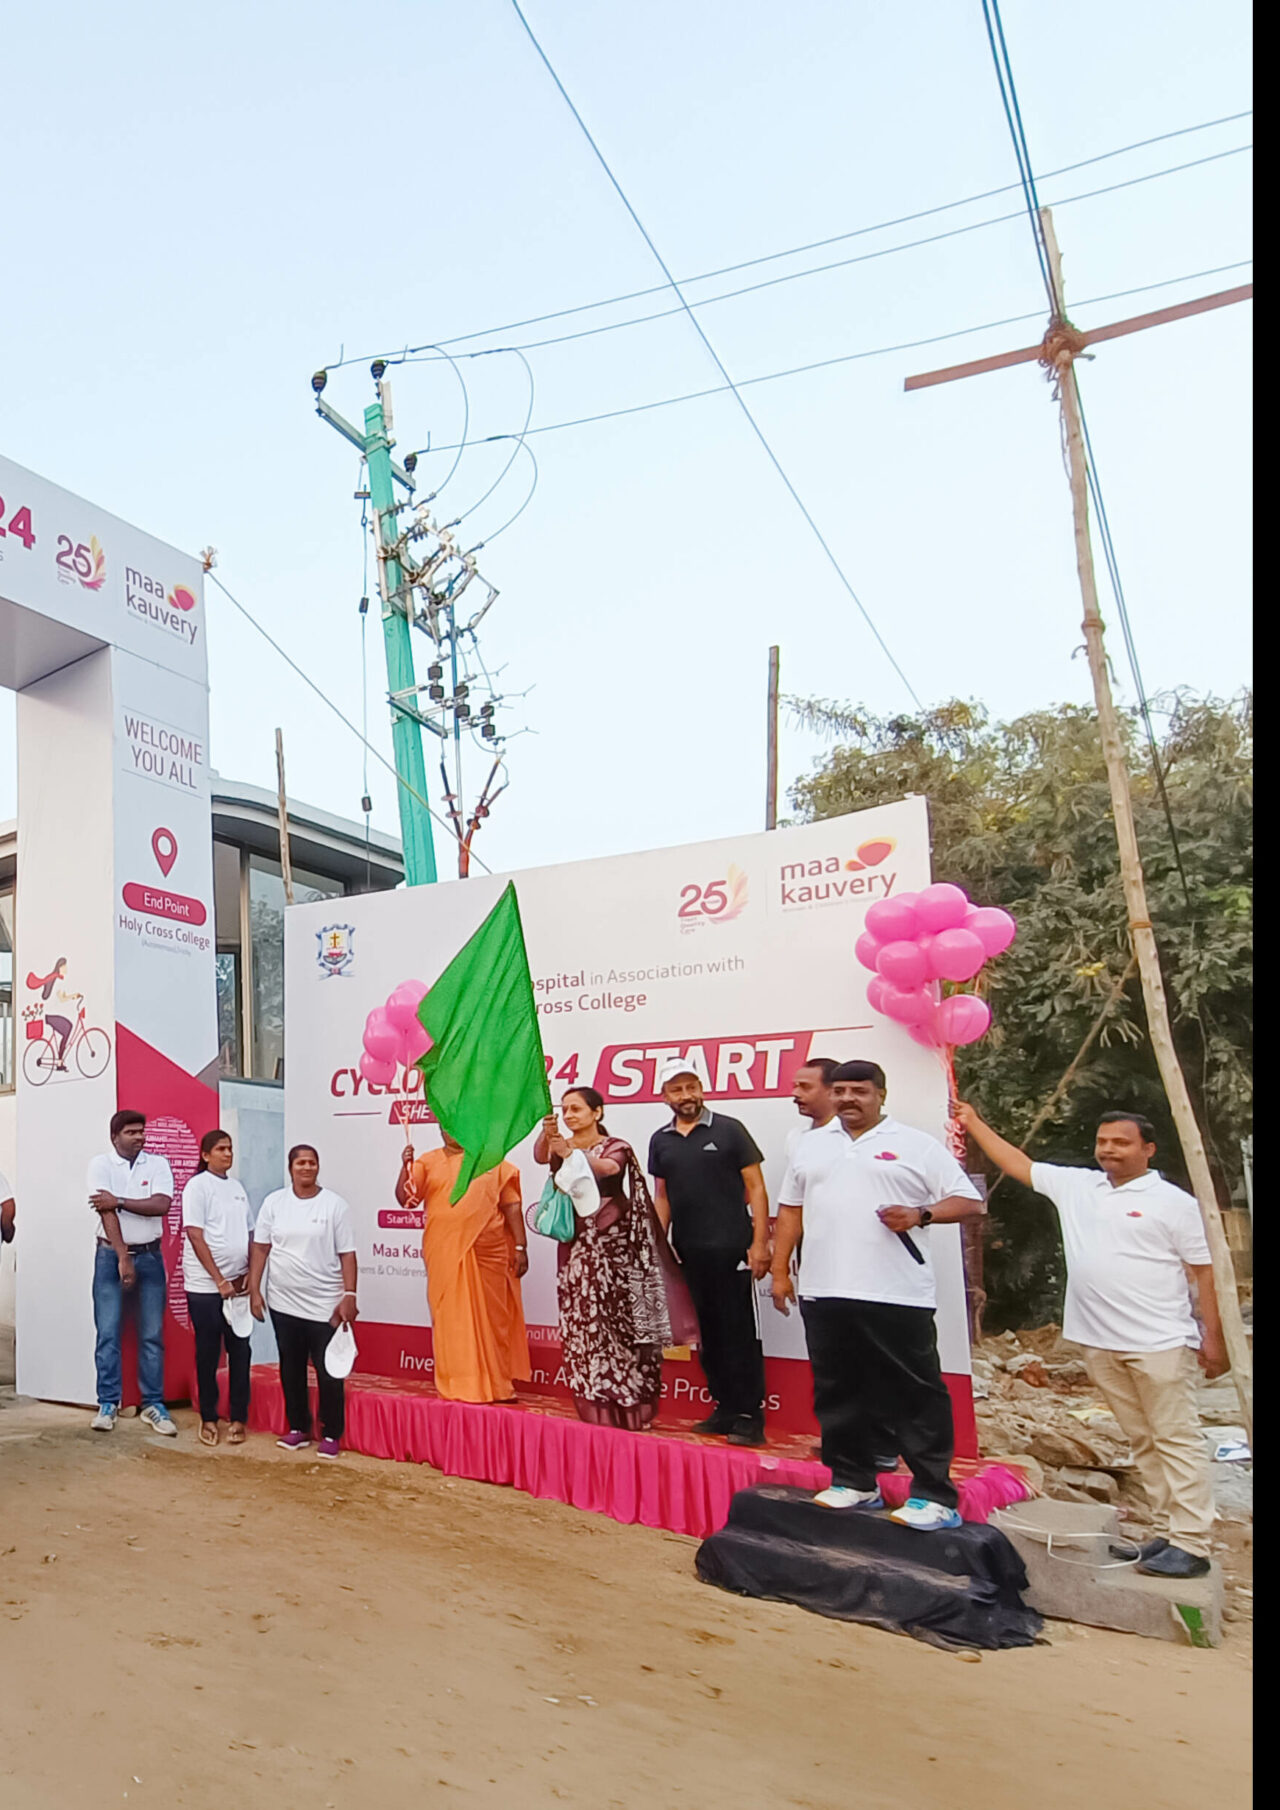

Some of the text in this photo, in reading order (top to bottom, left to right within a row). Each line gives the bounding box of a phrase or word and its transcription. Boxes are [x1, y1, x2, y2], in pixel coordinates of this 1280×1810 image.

[56, 534, 92, 578] 25
[125, 566, 165, 599] maa
[126, 584, 198, 645] kauvery
[124, 714, 203, 766] WELCOME
[131, 745, 197, 789] YOU ALL
[780, 856, 840, 881] maa
[144, 891, 190, 917] End Point
[678, 880, 728, 918] 25
[781, 872, 897, 906] kauvery
[119, 914, 143, 936] Holy
[145, 920, 174, 940] Cross
[175, 928, 211, 950] College
[590, 972, 603, 986] in
[606, 959, 703, 984] Association
[707, 956, 745, 973] with
[535, 992, 647, 1016] ross College
[608, 1038, 795, 1098] START
[373, 1243, 399, 1258] Maa
[400, 1350, 434, 1371] Inve
